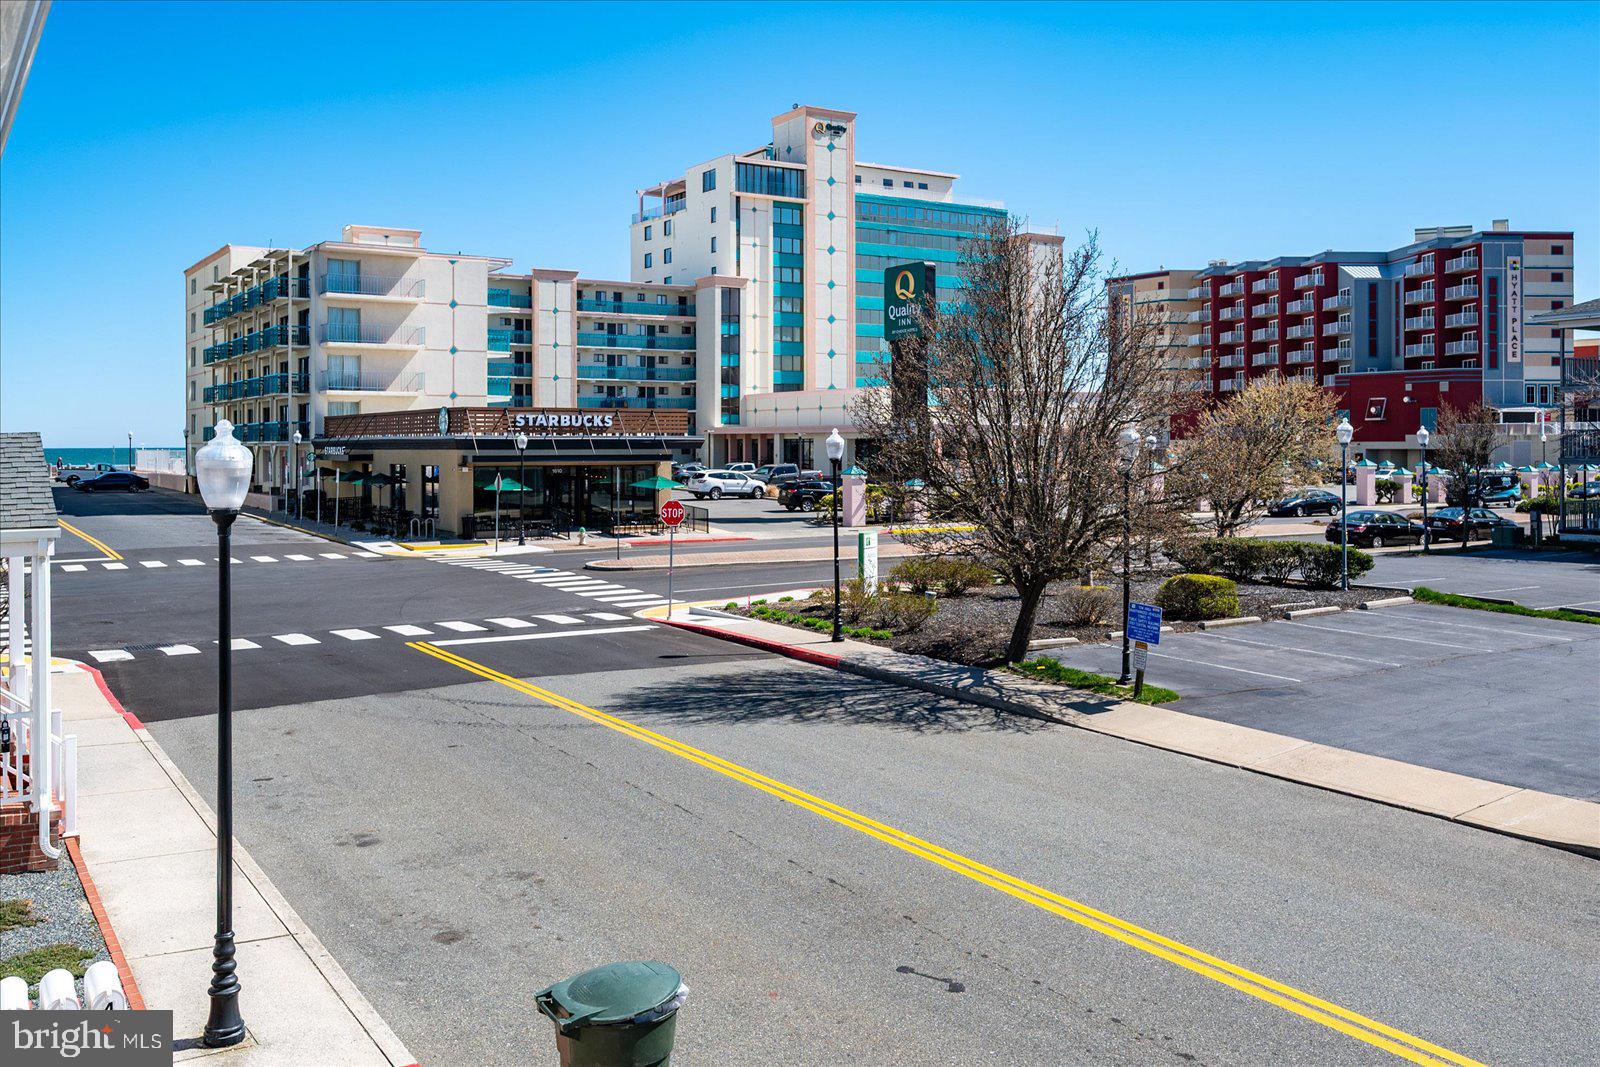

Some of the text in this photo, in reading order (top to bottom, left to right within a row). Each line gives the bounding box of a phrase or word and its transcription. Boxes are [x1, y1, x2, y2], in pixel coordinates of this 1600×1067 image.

[895, 270, 916, 300] Q
[898, 318, 911, 326] INN
[515, 414, 613, 427] STARBUCKS
[662, 508, 683, 518] STOP
